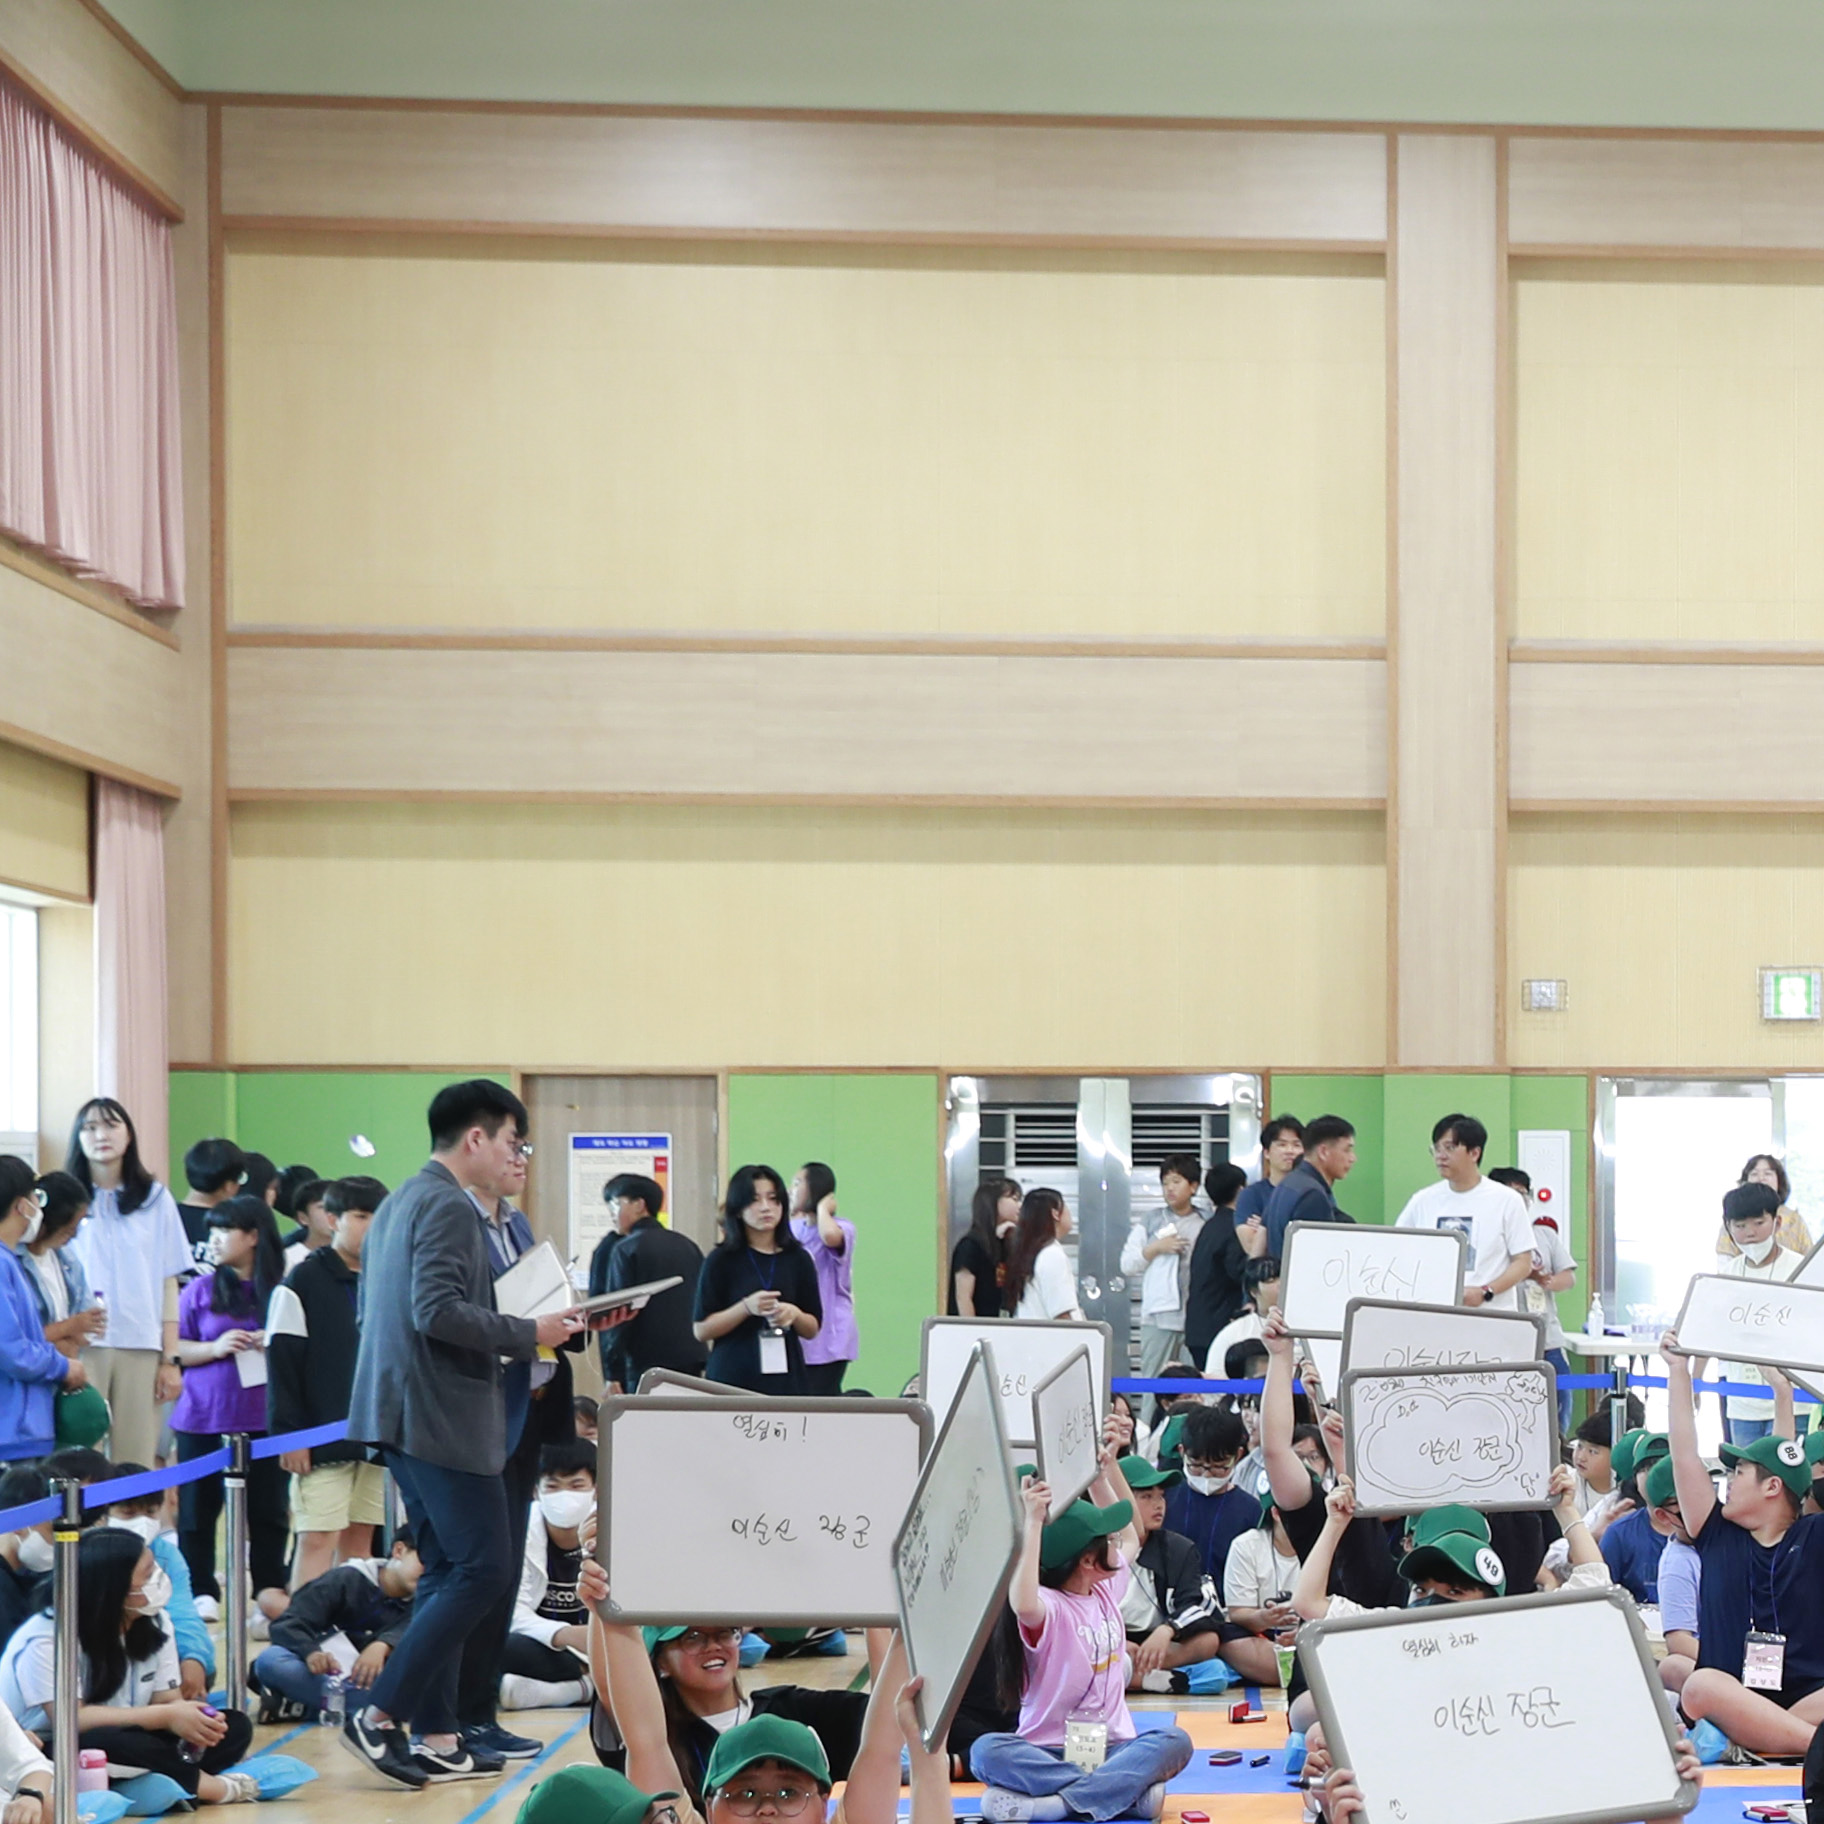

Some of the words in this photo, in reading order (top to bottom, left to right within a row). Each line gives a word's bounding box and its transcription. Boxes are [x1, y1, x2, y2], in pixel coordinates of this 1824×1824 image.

[1323, 1249, 1421, 1303] 이순신
[1728, 1302, 1792, 1327] 이순신
[999, 1374, 1028, 1397] 순신
[733, 1415, 789, 1441] 열심히
[1418, 1437, 1462, 1465] 이순신
[1473, 1435, 1503, 1462] 장군
[732, 1511, 798, 1547] 이순신
[818, 1513, 872, 1549] 장군
[1433, 1693, 1501, 1736] 이순신
[1506, 1686, 1577, 1729] 장군
